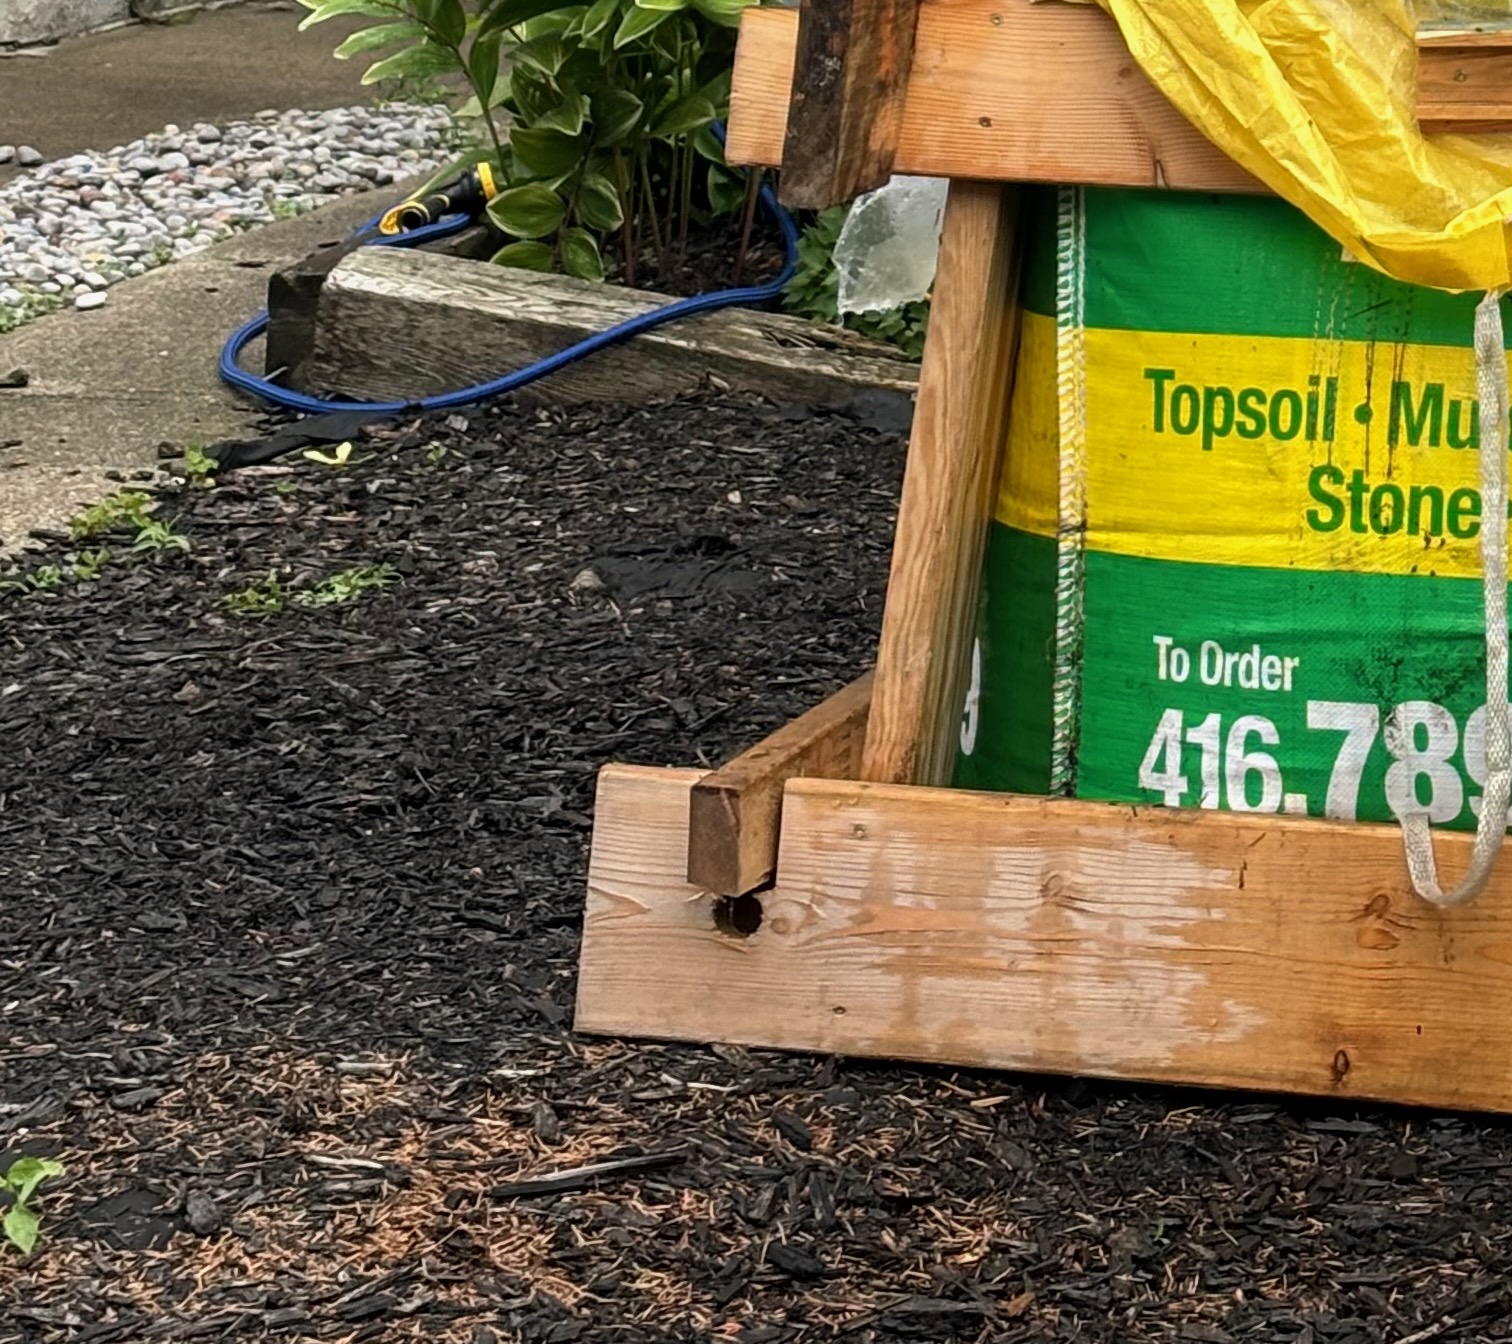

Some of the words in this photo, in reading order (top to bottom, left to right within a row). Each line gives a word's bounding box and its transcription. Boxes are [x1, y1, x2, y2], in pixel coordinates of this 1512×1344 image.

[1144, 368, 1338, 451] Topsoil
[1306, 465, 1483, 540] Stone
[1152, 636, 1190, 684] To
[1201, 640, 1299, 692] Order
